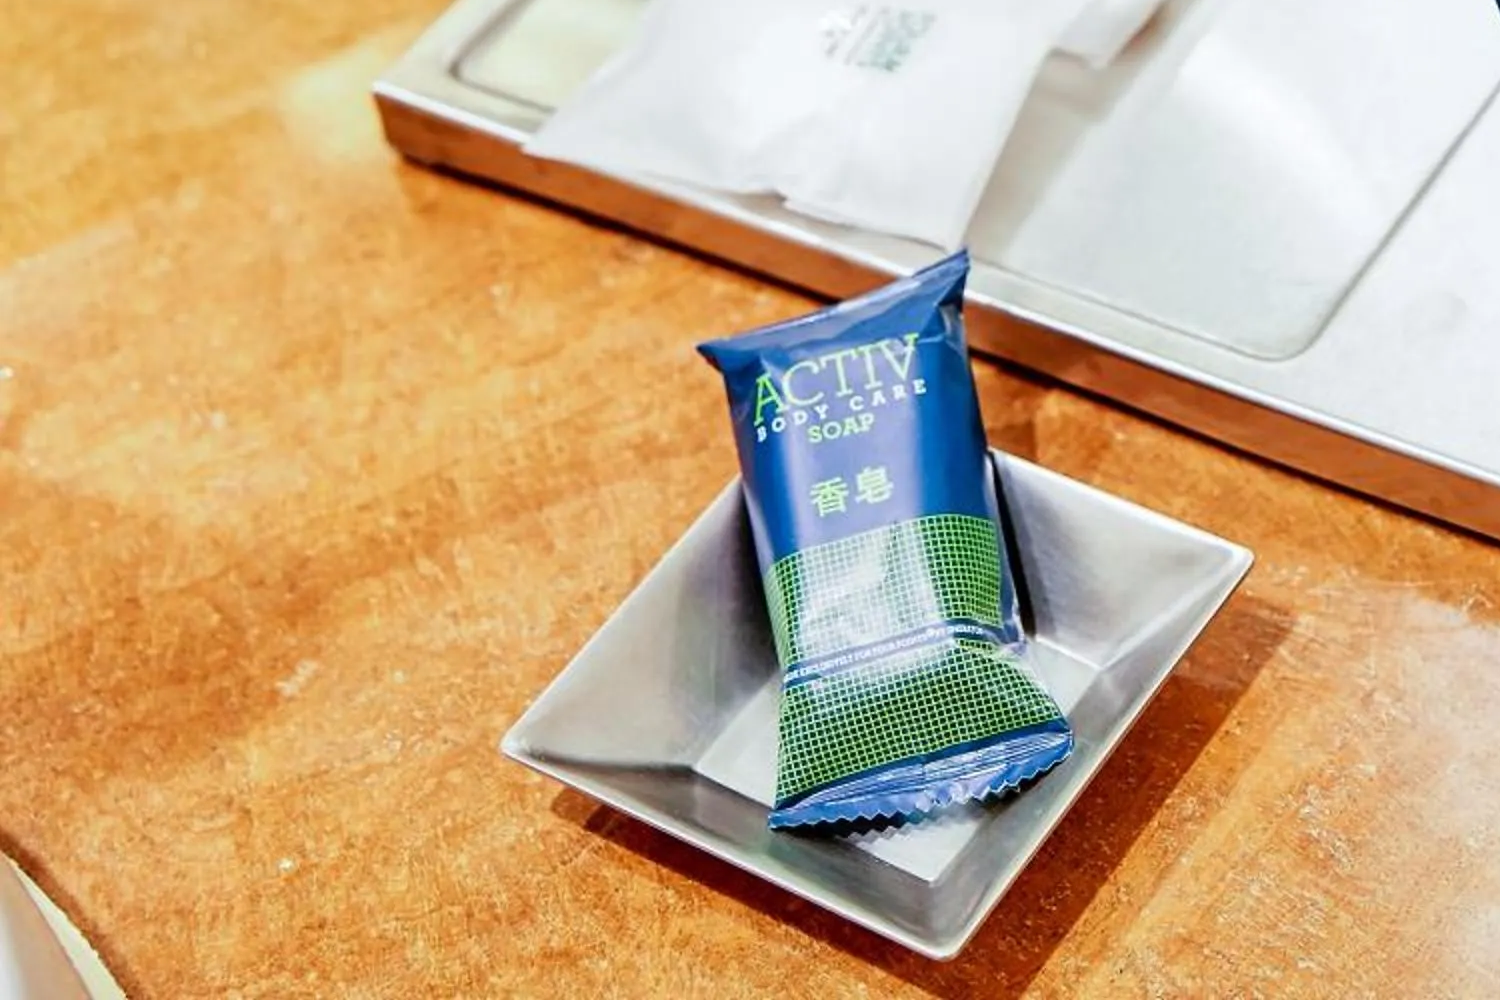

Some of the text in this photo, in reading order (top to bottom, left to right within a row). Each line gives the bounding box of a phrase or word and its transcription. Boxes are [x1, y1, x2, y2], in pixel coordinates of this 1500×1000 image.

[754, 332, 919, 427] ACTIV
[757, 378, 928, 443] BODY CARE
[808, 412, 875, 443] SOAP
[809, 465, 894, 518] 香皂
